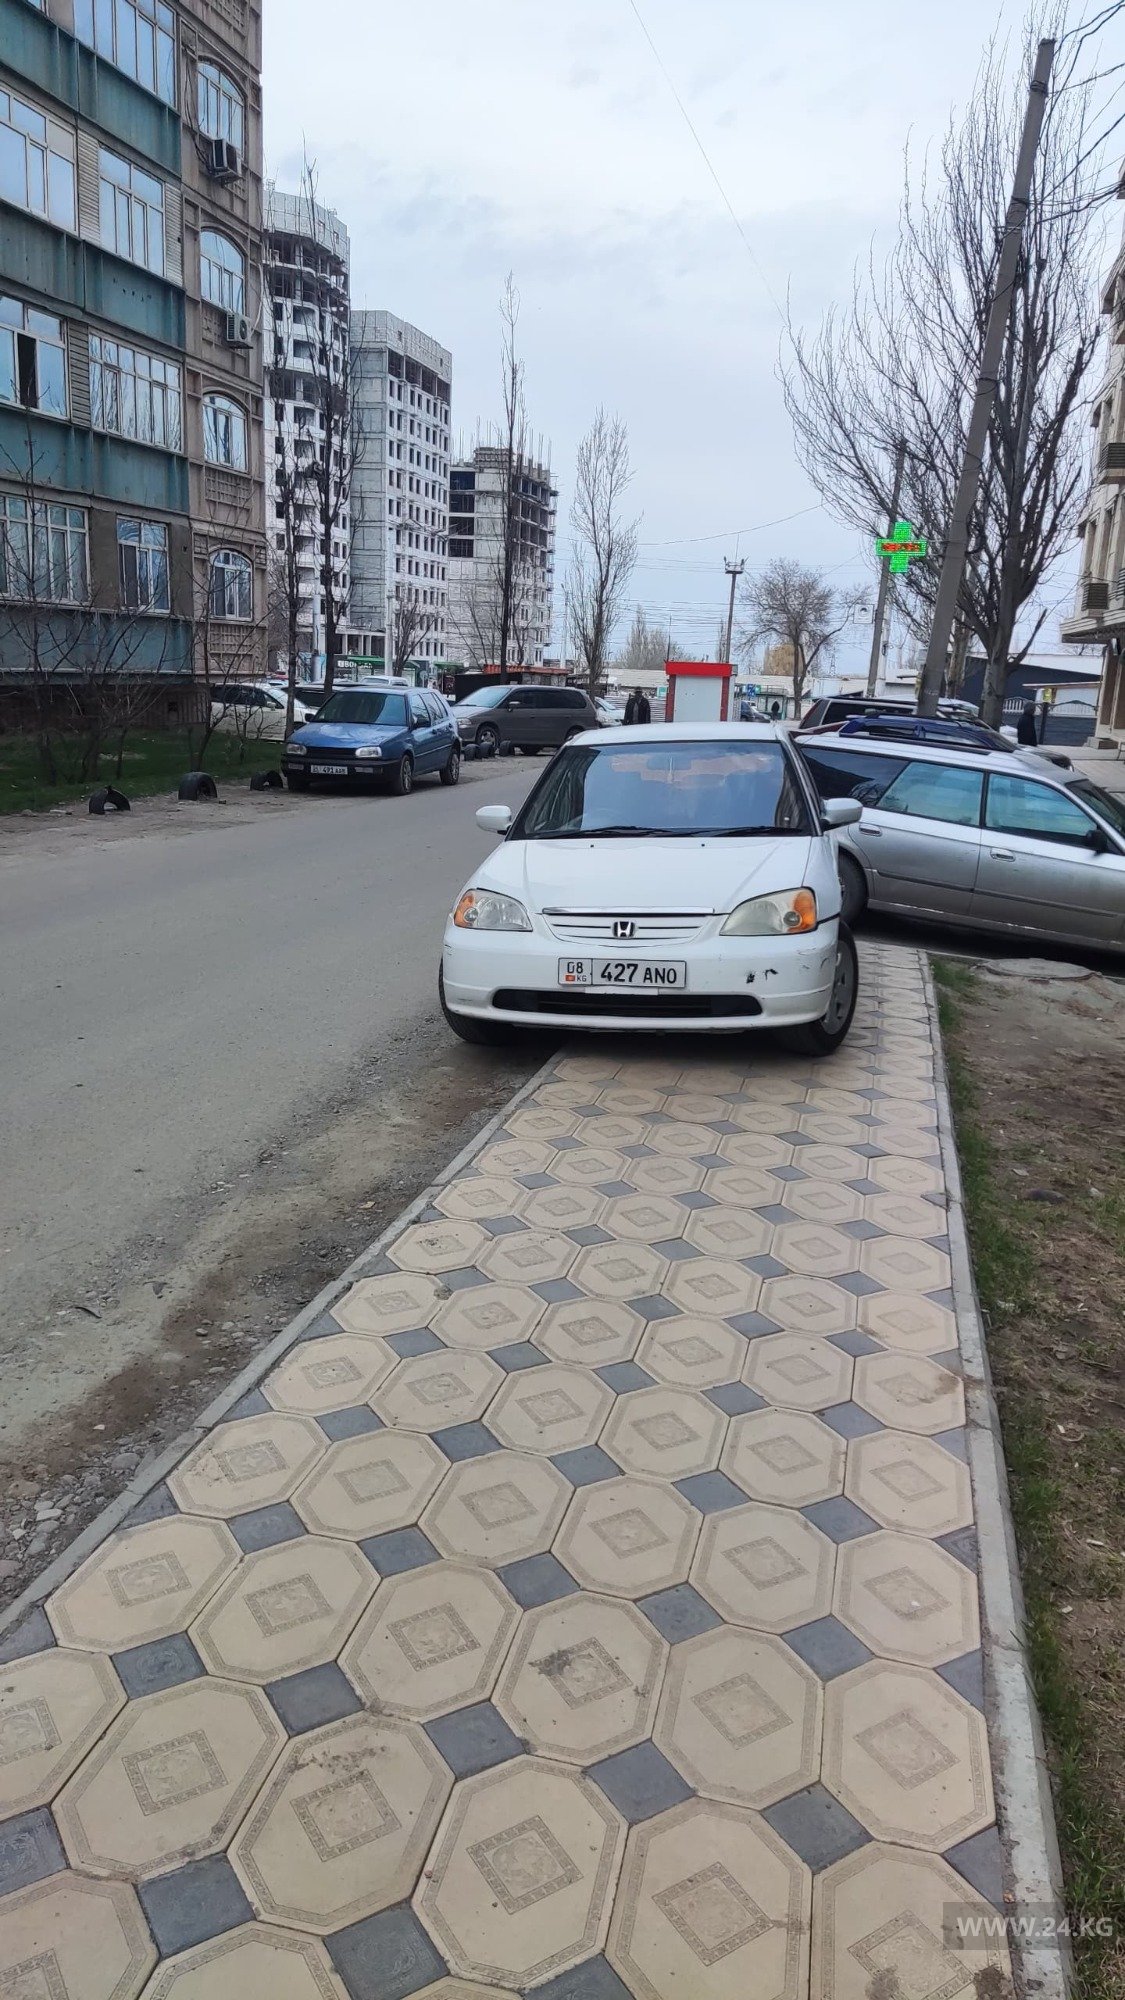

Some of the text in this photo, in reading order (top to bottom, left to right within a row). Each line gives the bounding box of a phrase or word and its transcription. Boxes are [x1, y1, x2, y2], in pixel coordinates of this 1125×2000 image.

[566, 961, 678, 984] 08 427 ANO
